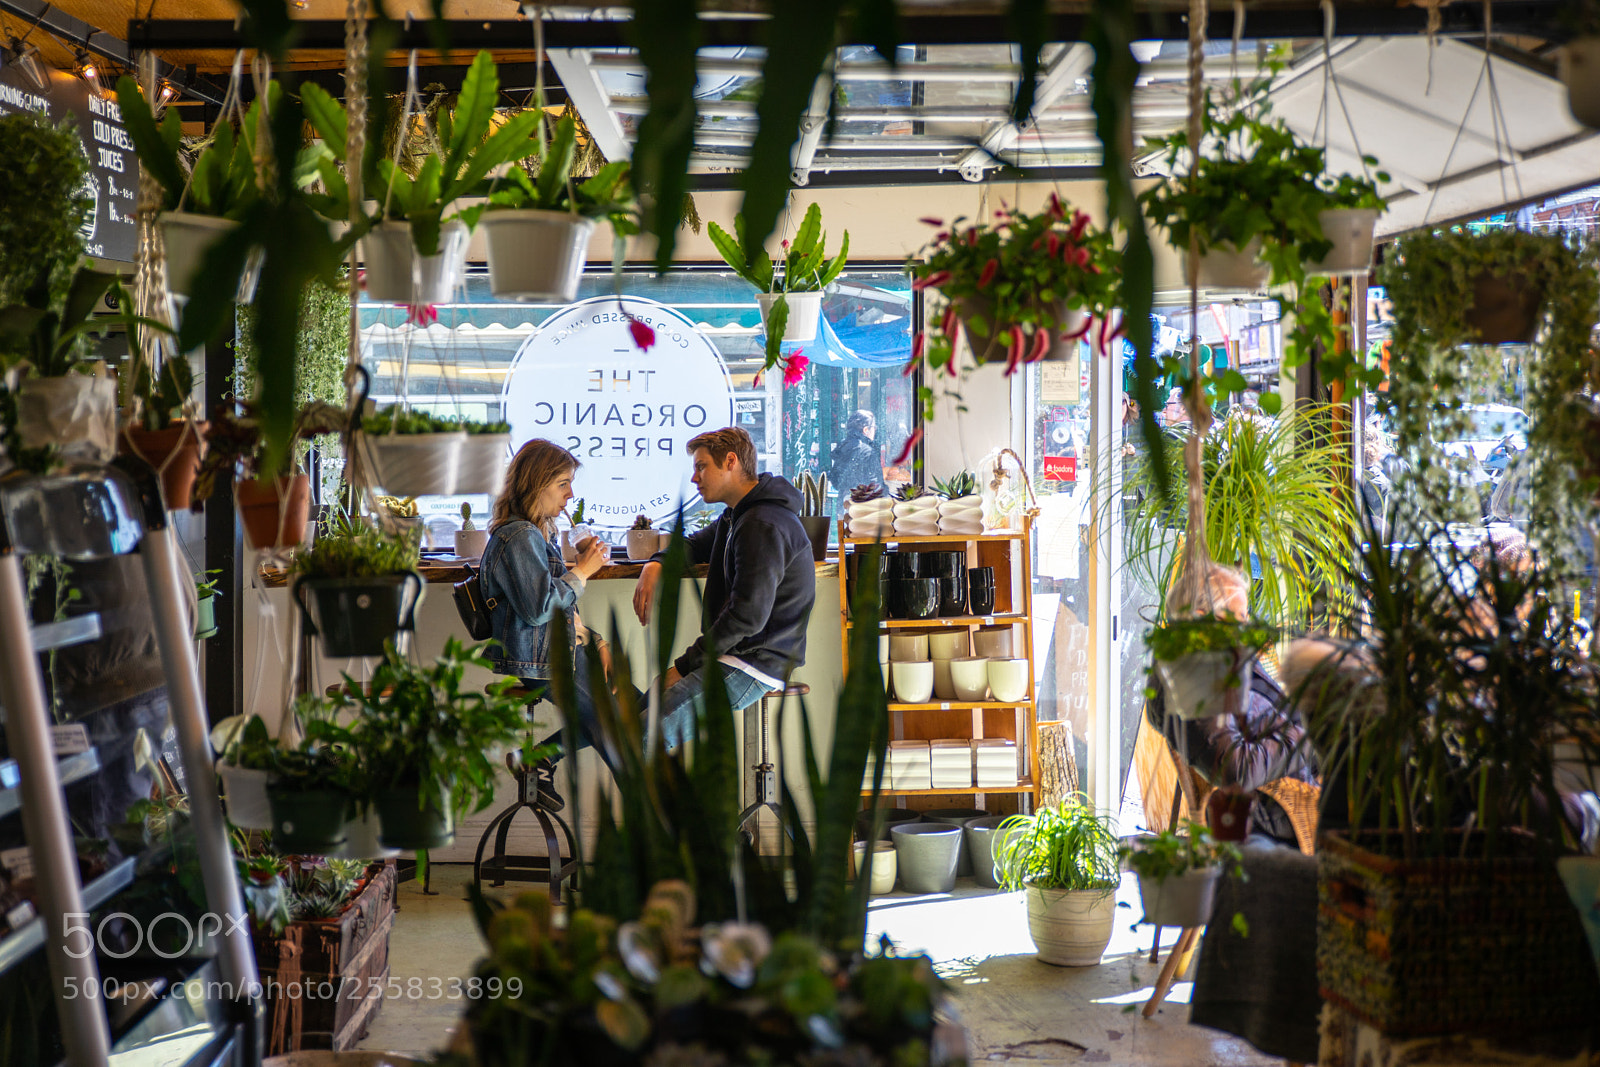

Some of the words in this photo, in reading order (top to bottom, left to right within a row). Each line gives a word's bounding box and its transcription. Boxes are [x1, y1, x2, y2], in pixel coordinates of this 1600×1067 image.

[88, 94, 105, 116] DAILY
[106, 100, 124, 123] FRE
[93, 120, 110, 143] COLD
[97, 147, 124, 173] JUICES
[1053, 464, 1073, 473] foodora
